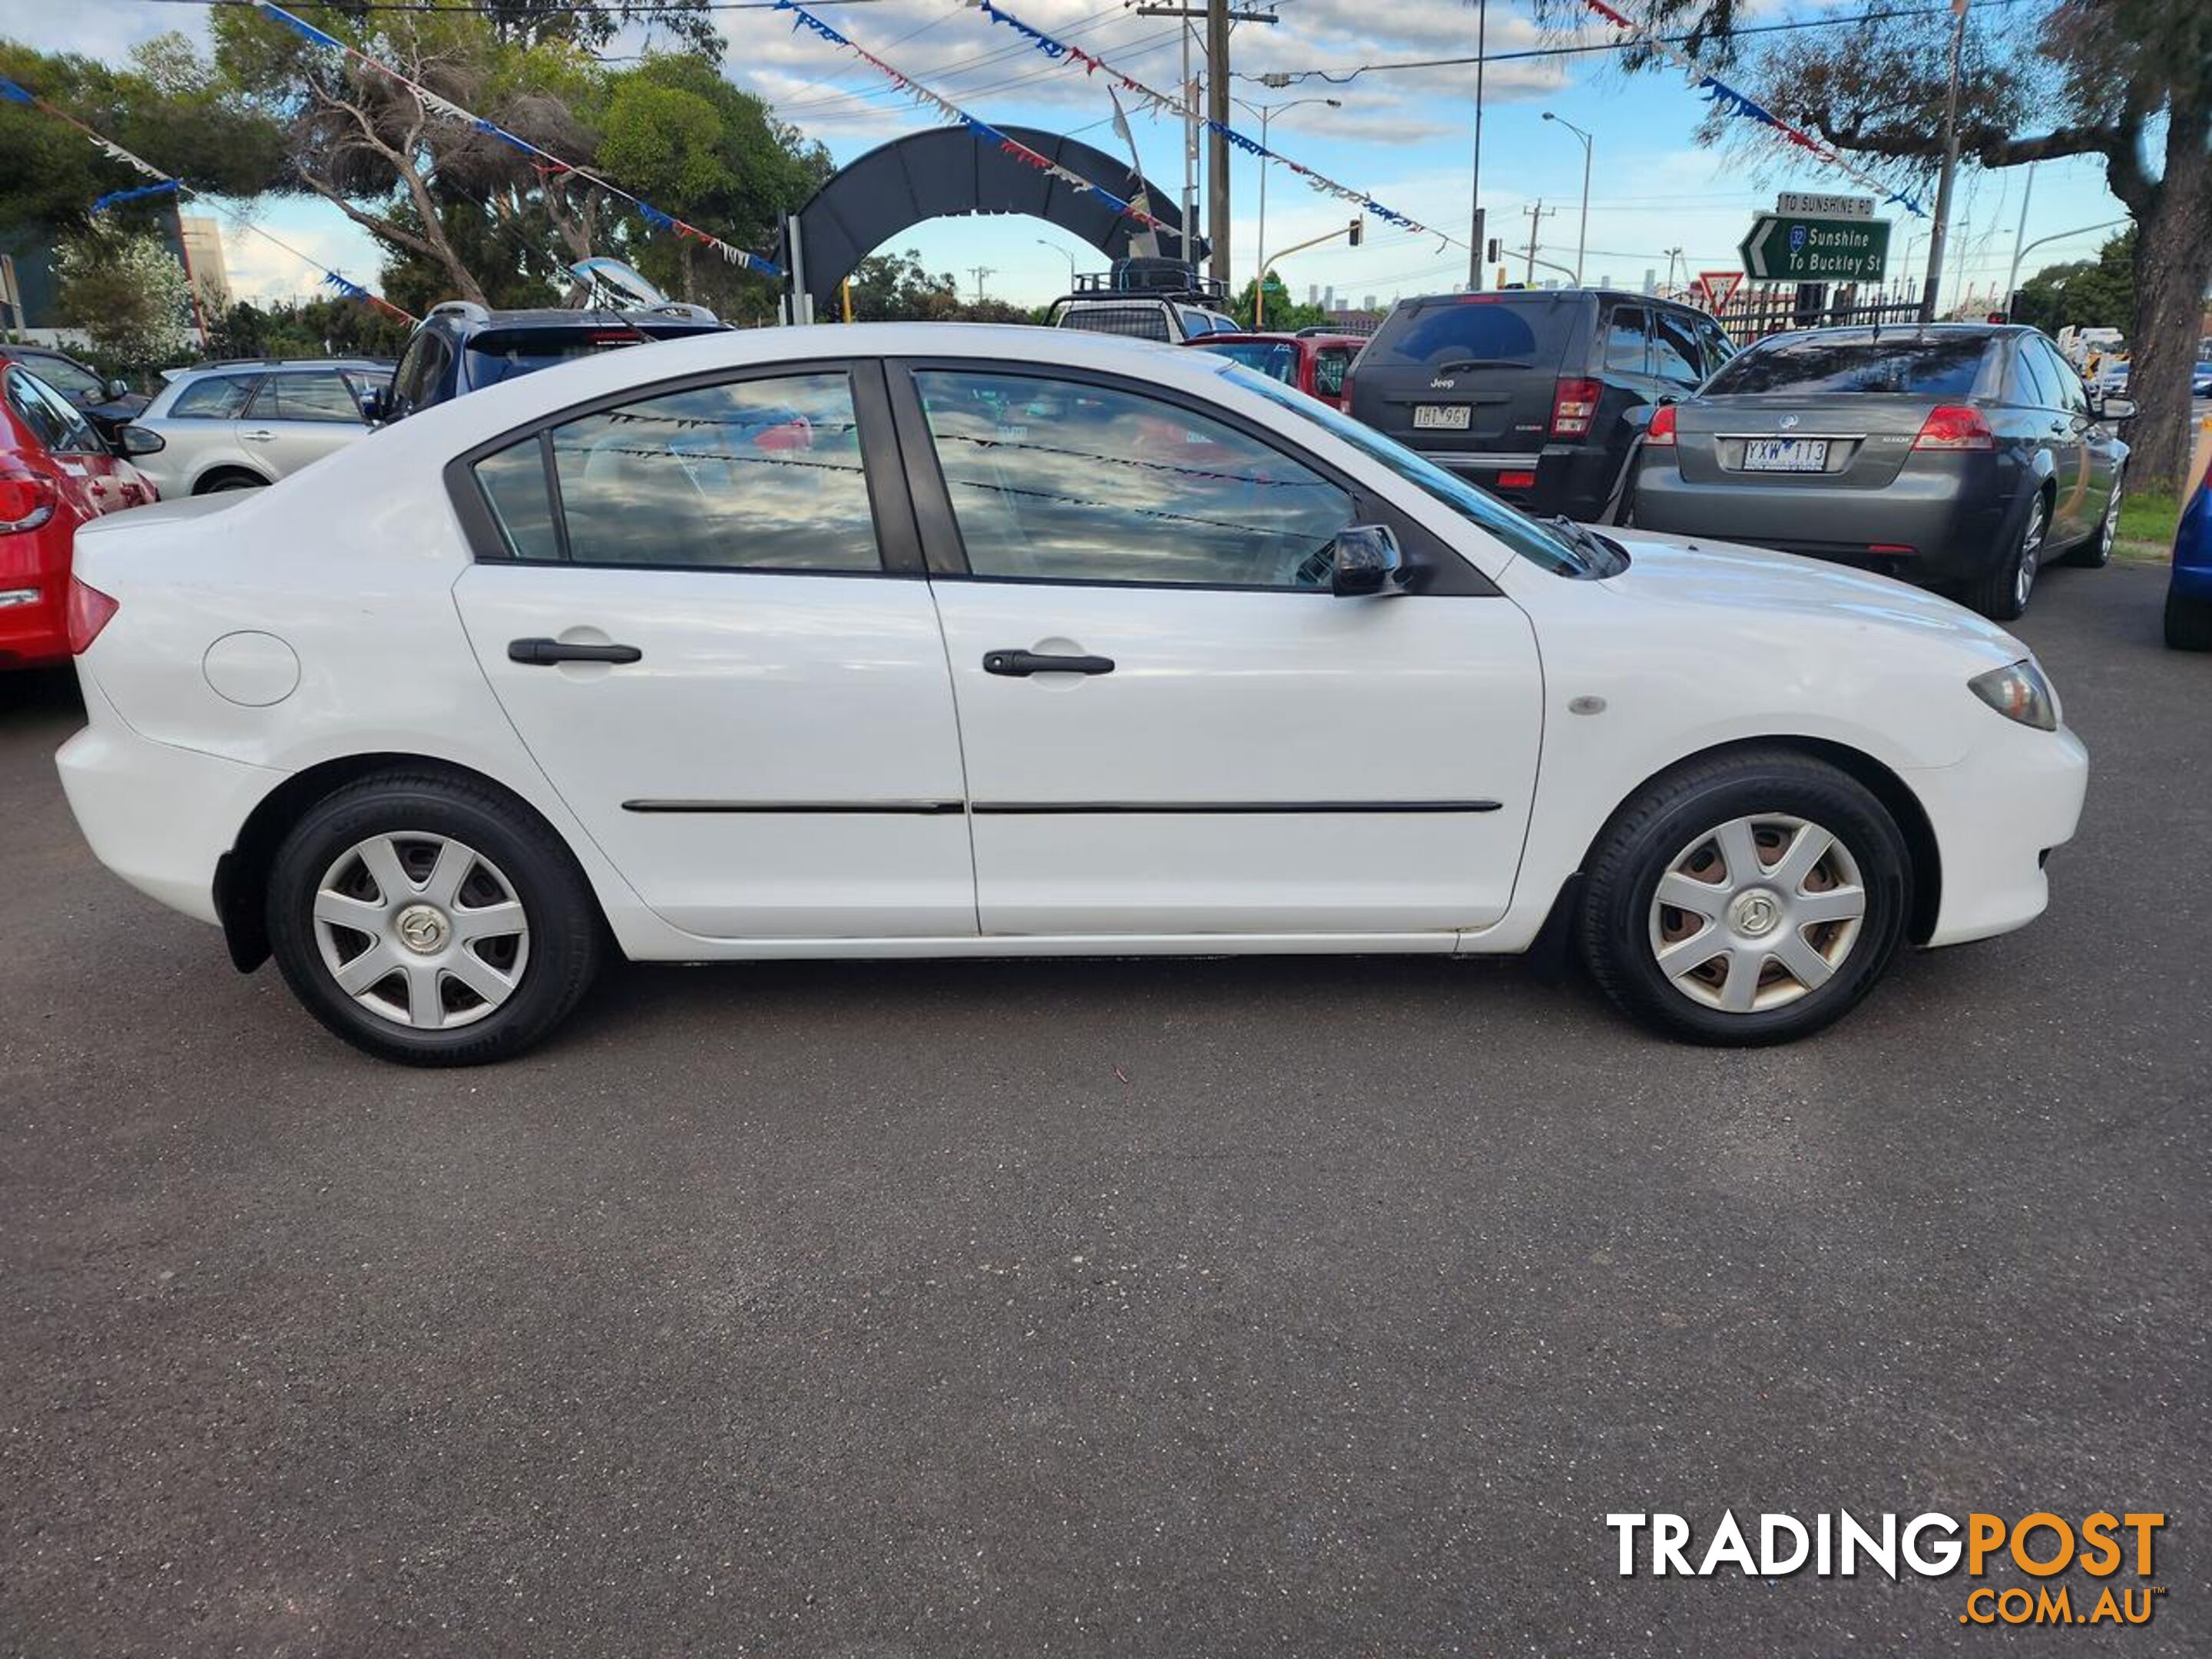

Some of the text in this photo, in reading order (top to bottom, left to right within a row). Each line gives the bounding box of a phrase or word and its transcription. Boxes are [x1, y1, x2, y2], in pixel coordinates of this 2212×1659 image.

[1785, 195, 1872, 214] TO SUNSHINE RD
[1793, 228, 1869, 247] 32 Sunshine
[1790, 253, 1881, 275] To Buckley St
[1430, 378, 1455, 389] Jeep
[1795, 442, 1824, 461] 113
